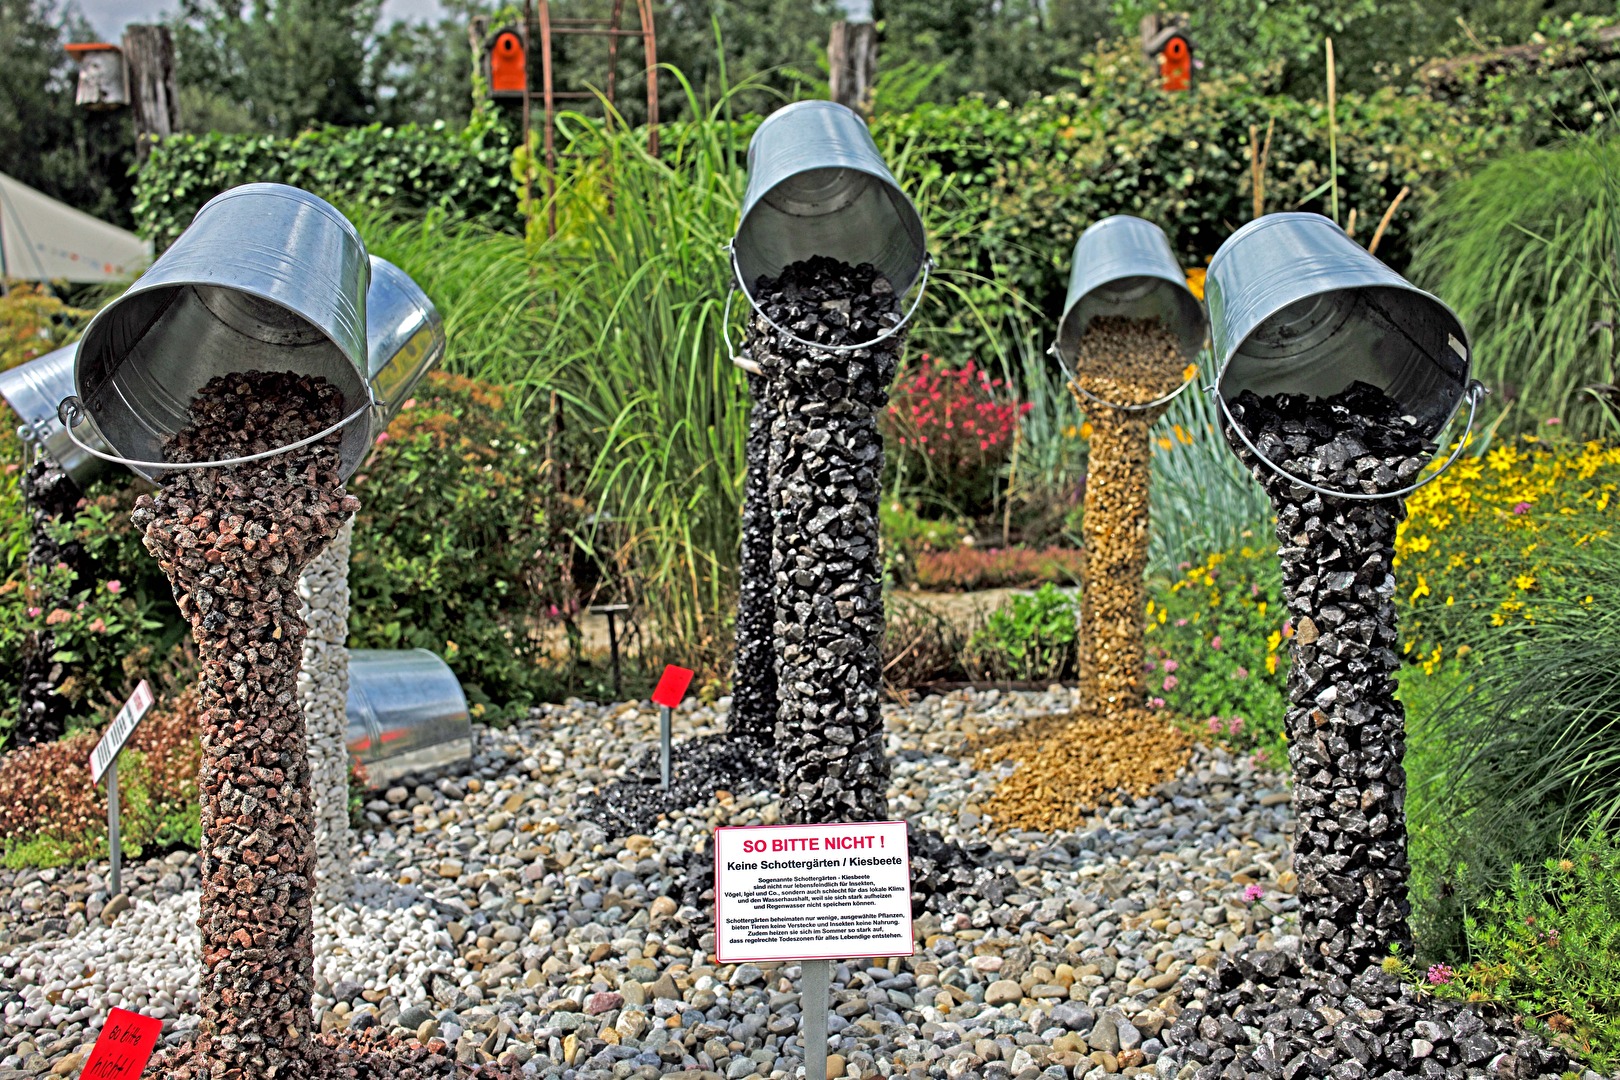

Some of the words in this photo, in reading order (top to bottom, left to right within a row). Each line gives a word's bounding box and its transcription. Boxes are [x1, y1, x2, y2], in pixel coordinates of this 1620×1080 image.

[743, 840, 767, 853] SO
[772, 838, 819, 851] BITTE
[825, 836, 875, 850] NICHT
[880, 836, 884, 848] !
[728, 861, 757, 870] Keine
[761, 859, 840, 870] Schottergärten
[843, 858, 846, 866] /
[850, 857, 902, 866] Kiesbeete
